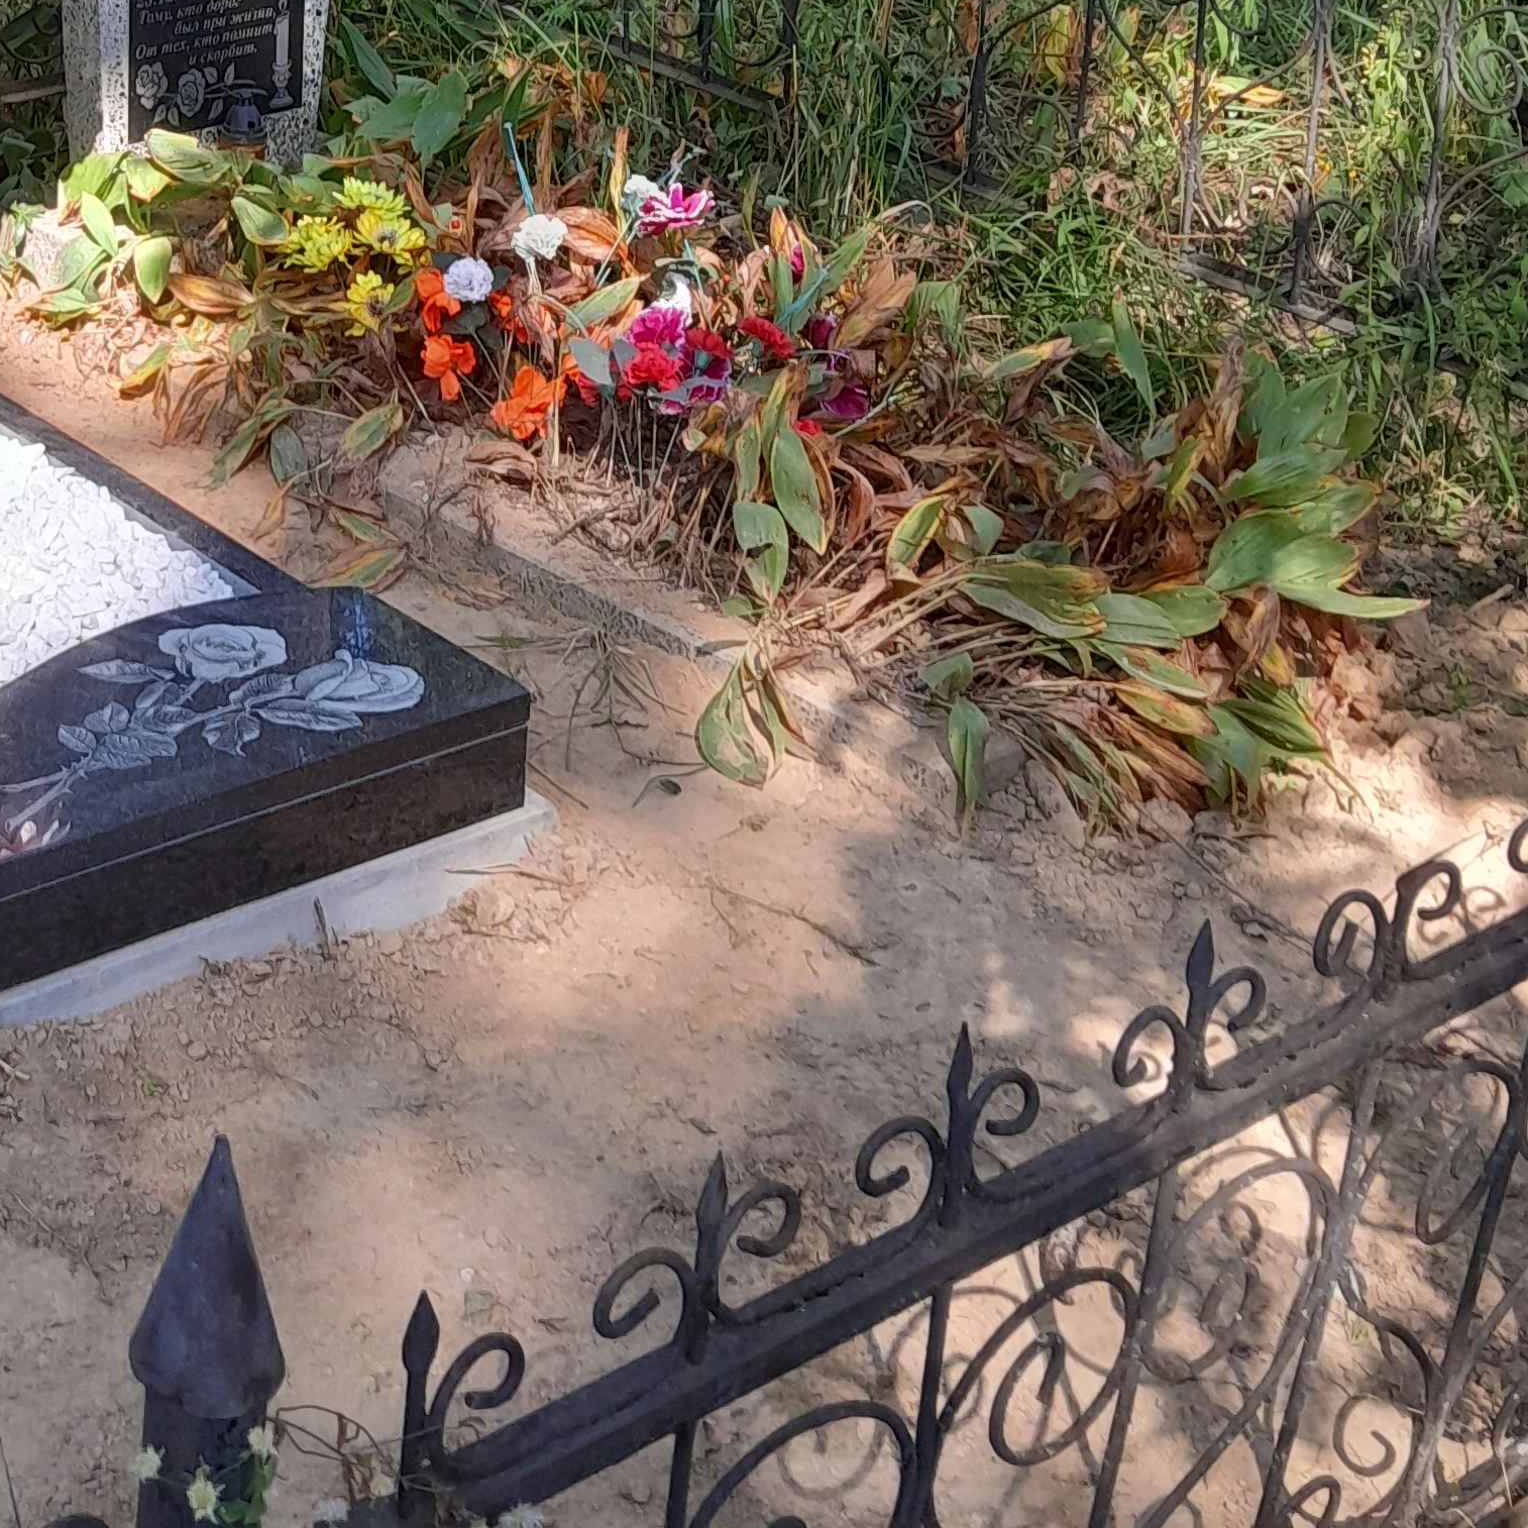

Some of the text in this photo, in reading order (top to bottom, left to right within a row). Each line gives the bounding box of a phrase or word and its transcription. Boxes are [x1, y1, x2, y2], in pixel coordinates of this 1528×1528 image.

[177, 4, 203, 19] кто
[135, 44, 157, 60] От
[193, 35, 220, 49] кто
[188, 54, 197, 65] и
